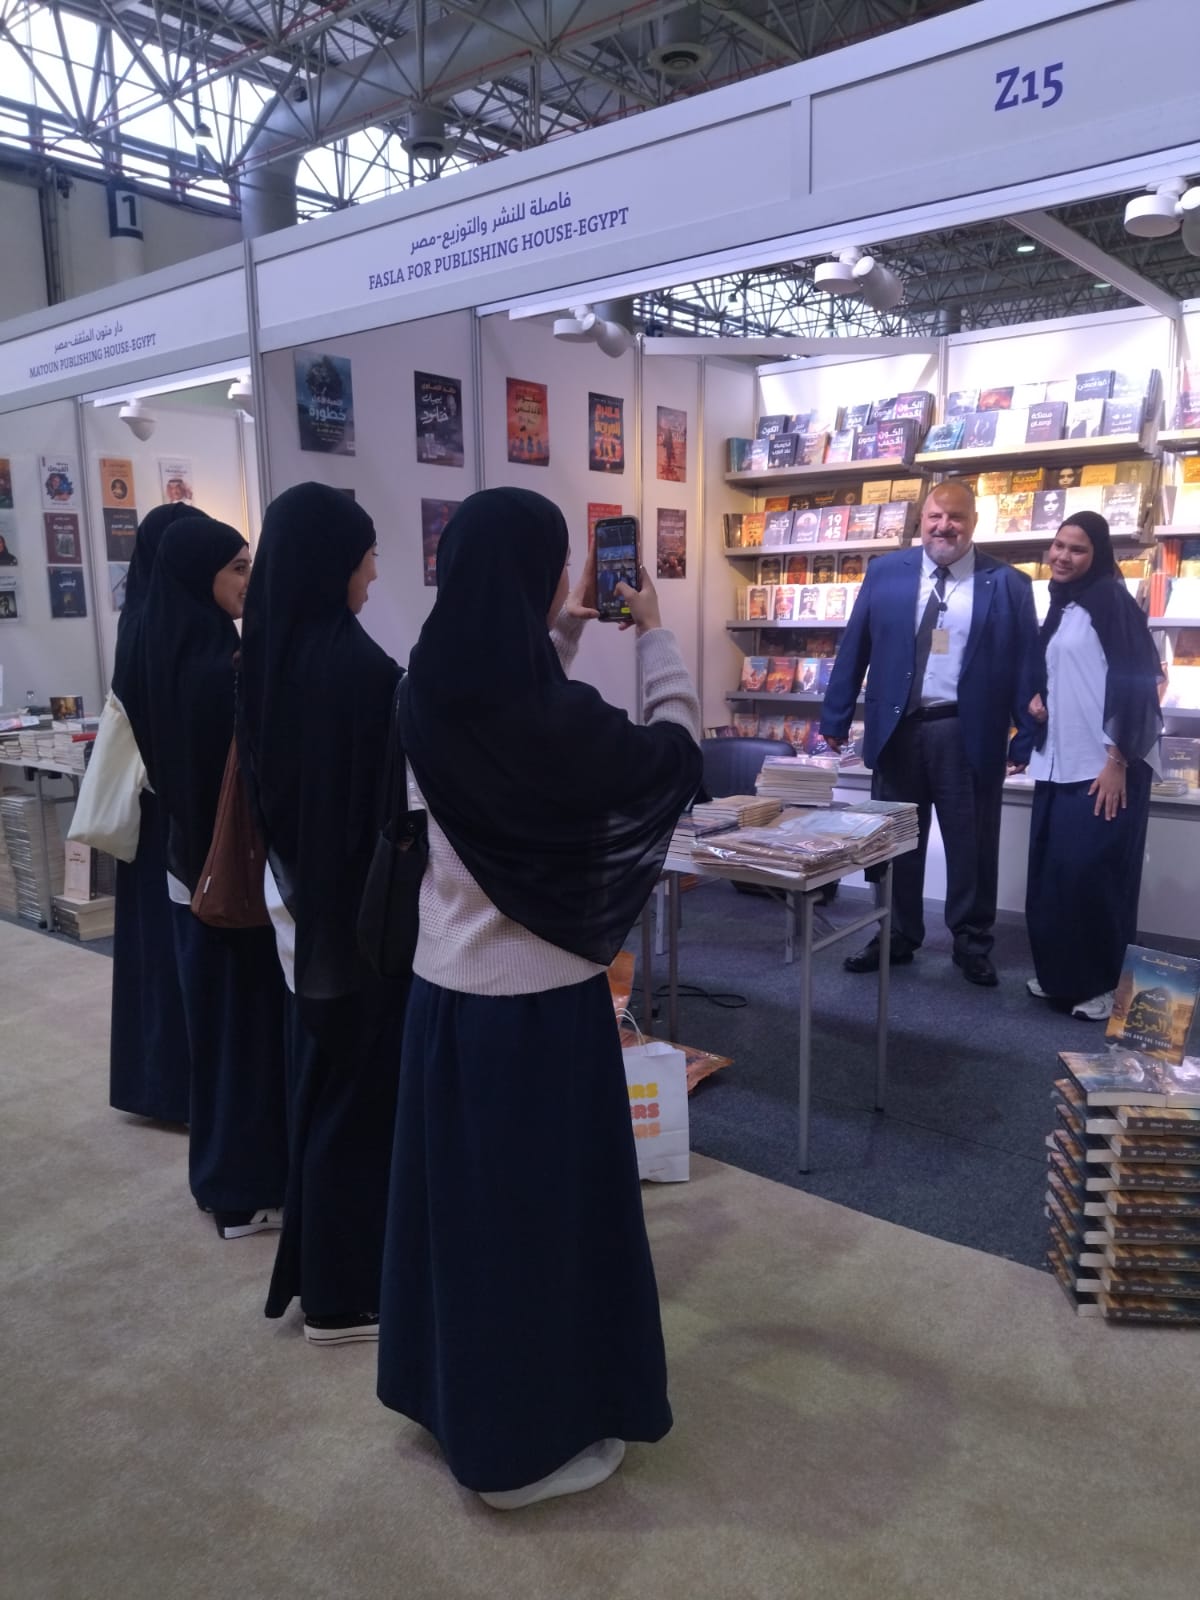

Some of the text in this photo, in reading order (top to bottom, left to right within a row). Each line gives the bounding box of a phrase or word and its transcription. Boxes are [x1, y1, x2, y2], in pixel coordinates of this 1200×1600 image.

[994, 62, 1064, 112] Z15
[529, 191, 571, 216] فاصلة
[492, 203, 526, 233] للنشر
[368, 207, 629, 290] FASLA FOR PUBLISHING HOUSE-EGYPT
[113, 320, 124, 337] دار
[29, 333, 157, 379] MATOUN PUBLISHING HOUSE-EGYPT
[825, 526, 842, 540] 45
[827, 513, 843, 526] 19
